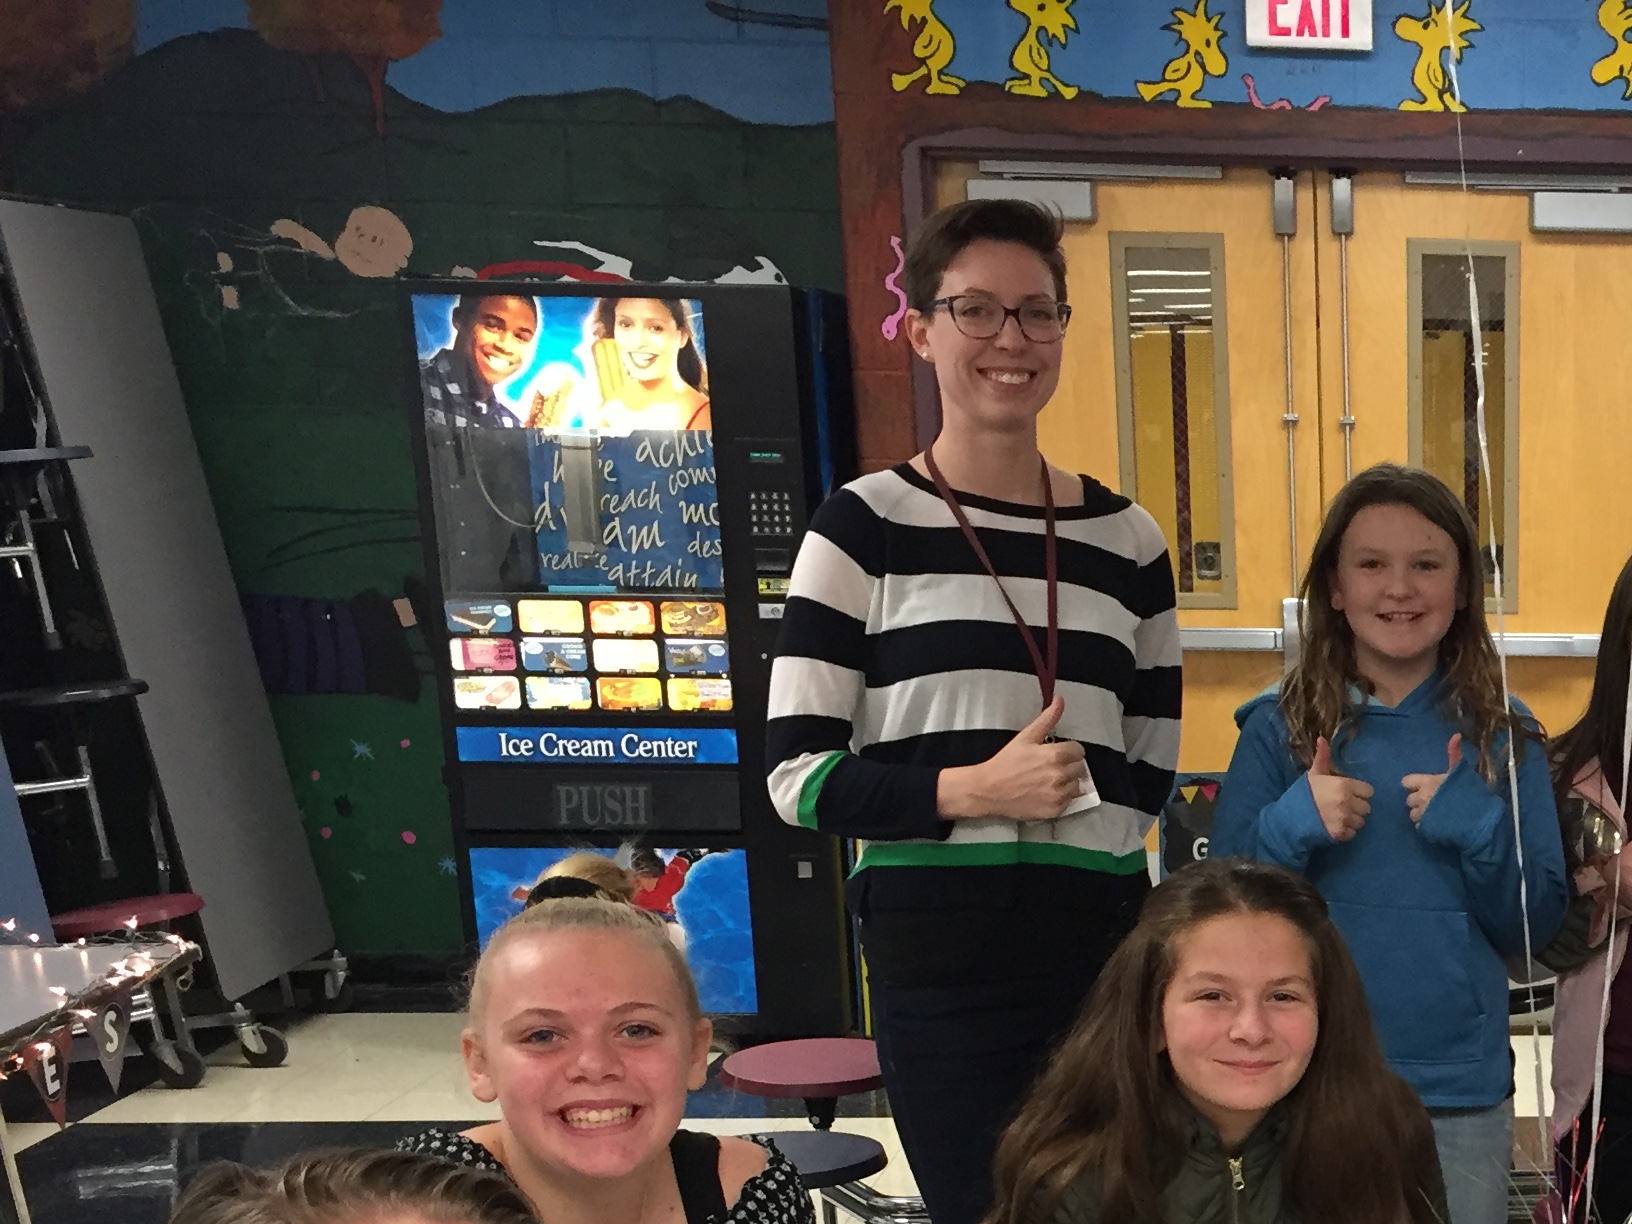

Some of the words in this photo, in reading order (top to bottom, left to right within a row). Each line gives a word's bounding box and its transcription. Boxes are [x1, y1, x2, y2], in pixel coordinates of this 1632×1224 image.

[599, 481, 663, 515] reach
[607, 558, 698, 588] attain
[499, 733, 535, 756] Ice
[539, 733, 615, 759] Cream
[620, 733, 698, 759] Center
[557, 784, 649, 826] PUSH
